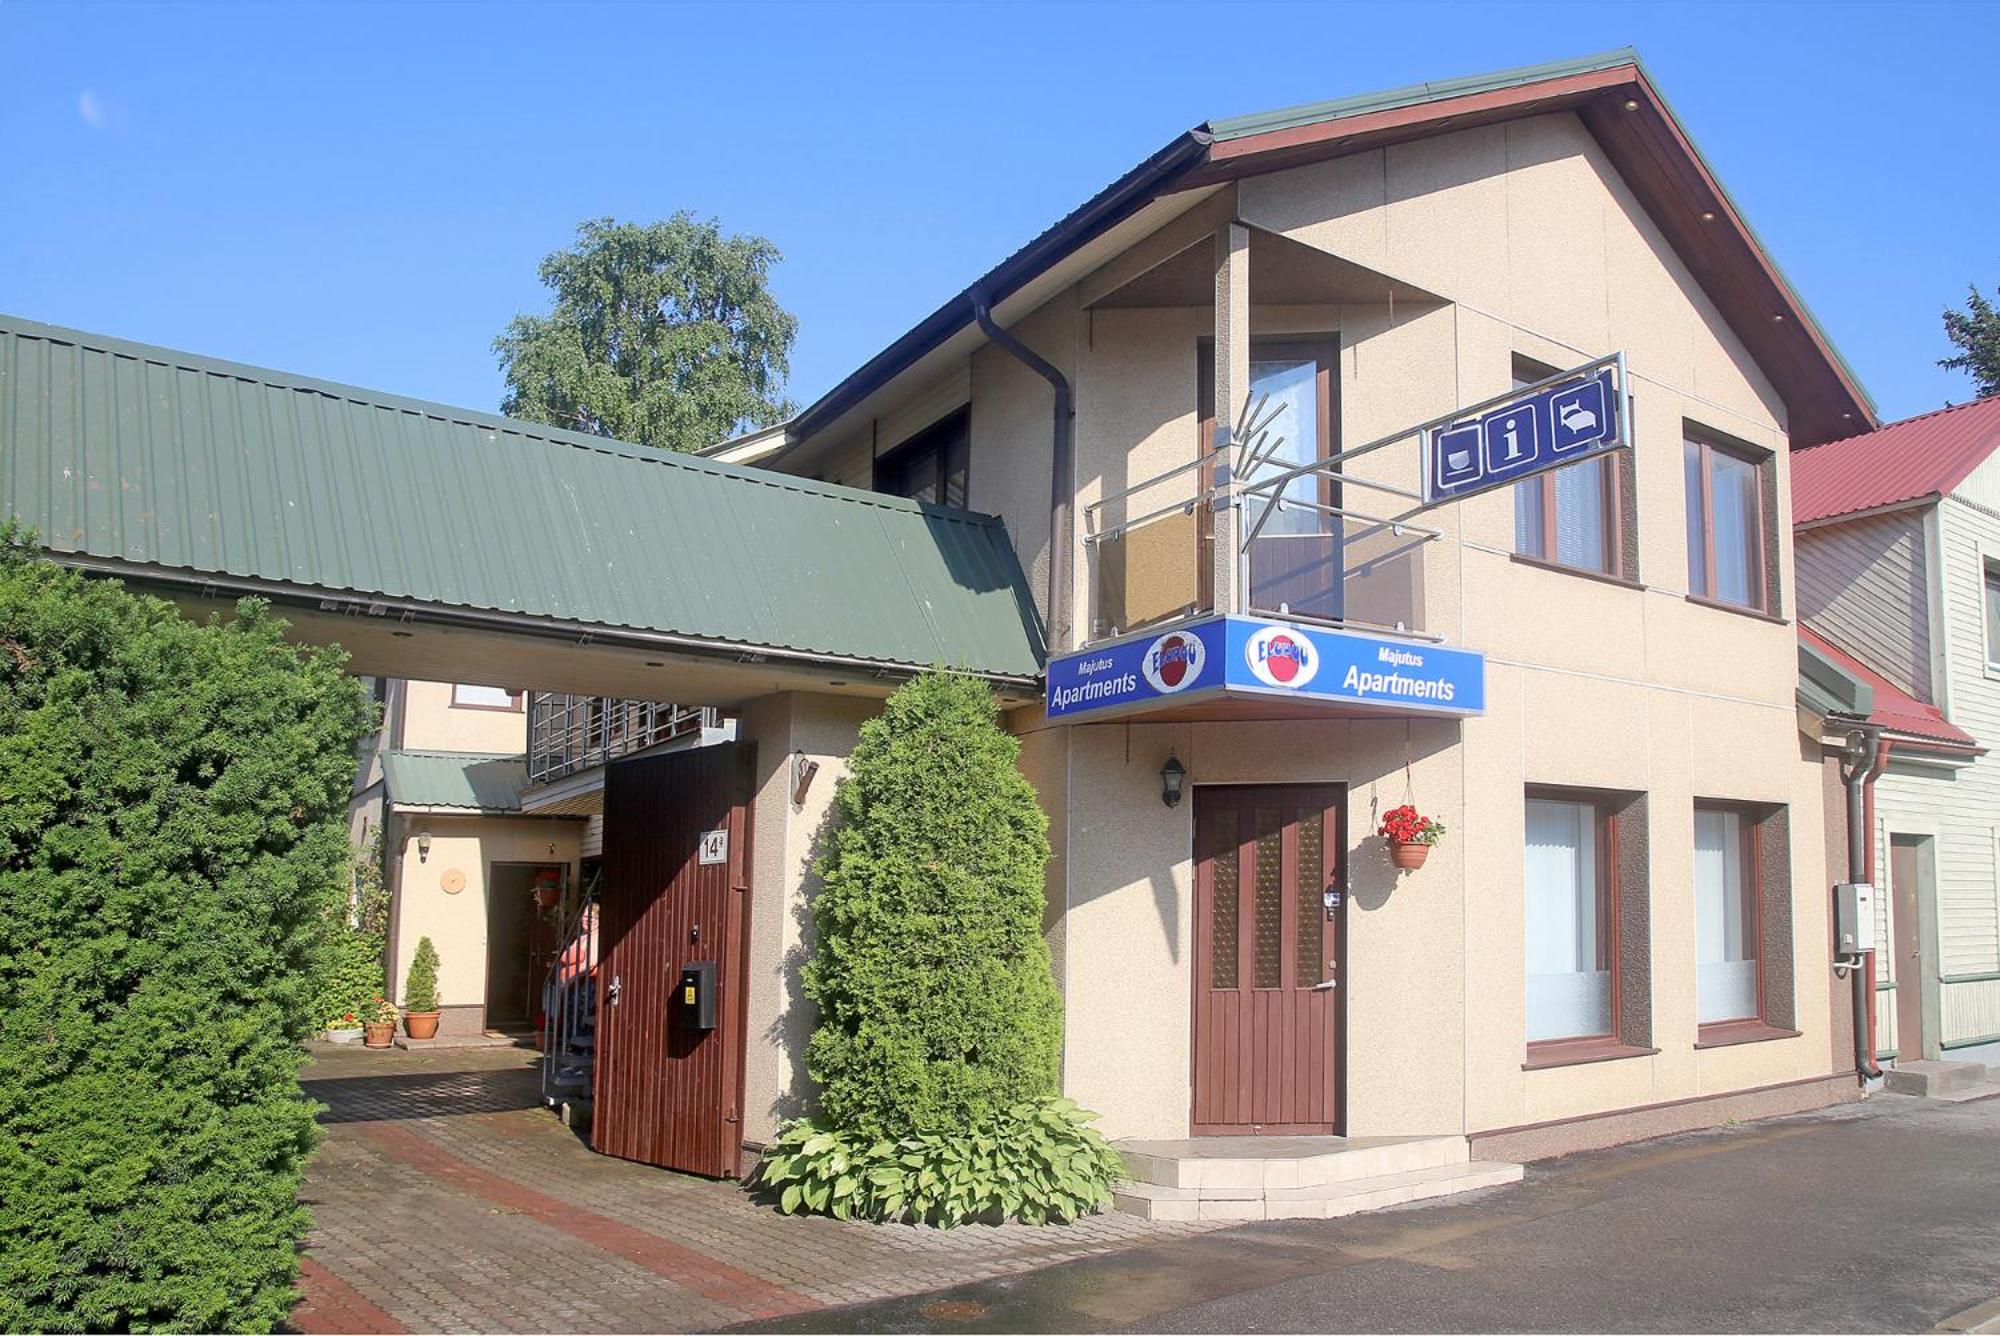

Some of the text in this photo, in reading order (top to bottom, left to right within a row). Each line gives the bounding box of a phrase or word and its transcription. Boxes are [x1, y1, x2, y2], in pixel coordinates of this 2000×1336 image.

[1078, 658, 1113, 676] Majutus
[1378, 646, 1424, 667] Majutus
[1051, 672, 1137, 711] Apartments
[1342, 664, 1455, 701] Apartments
